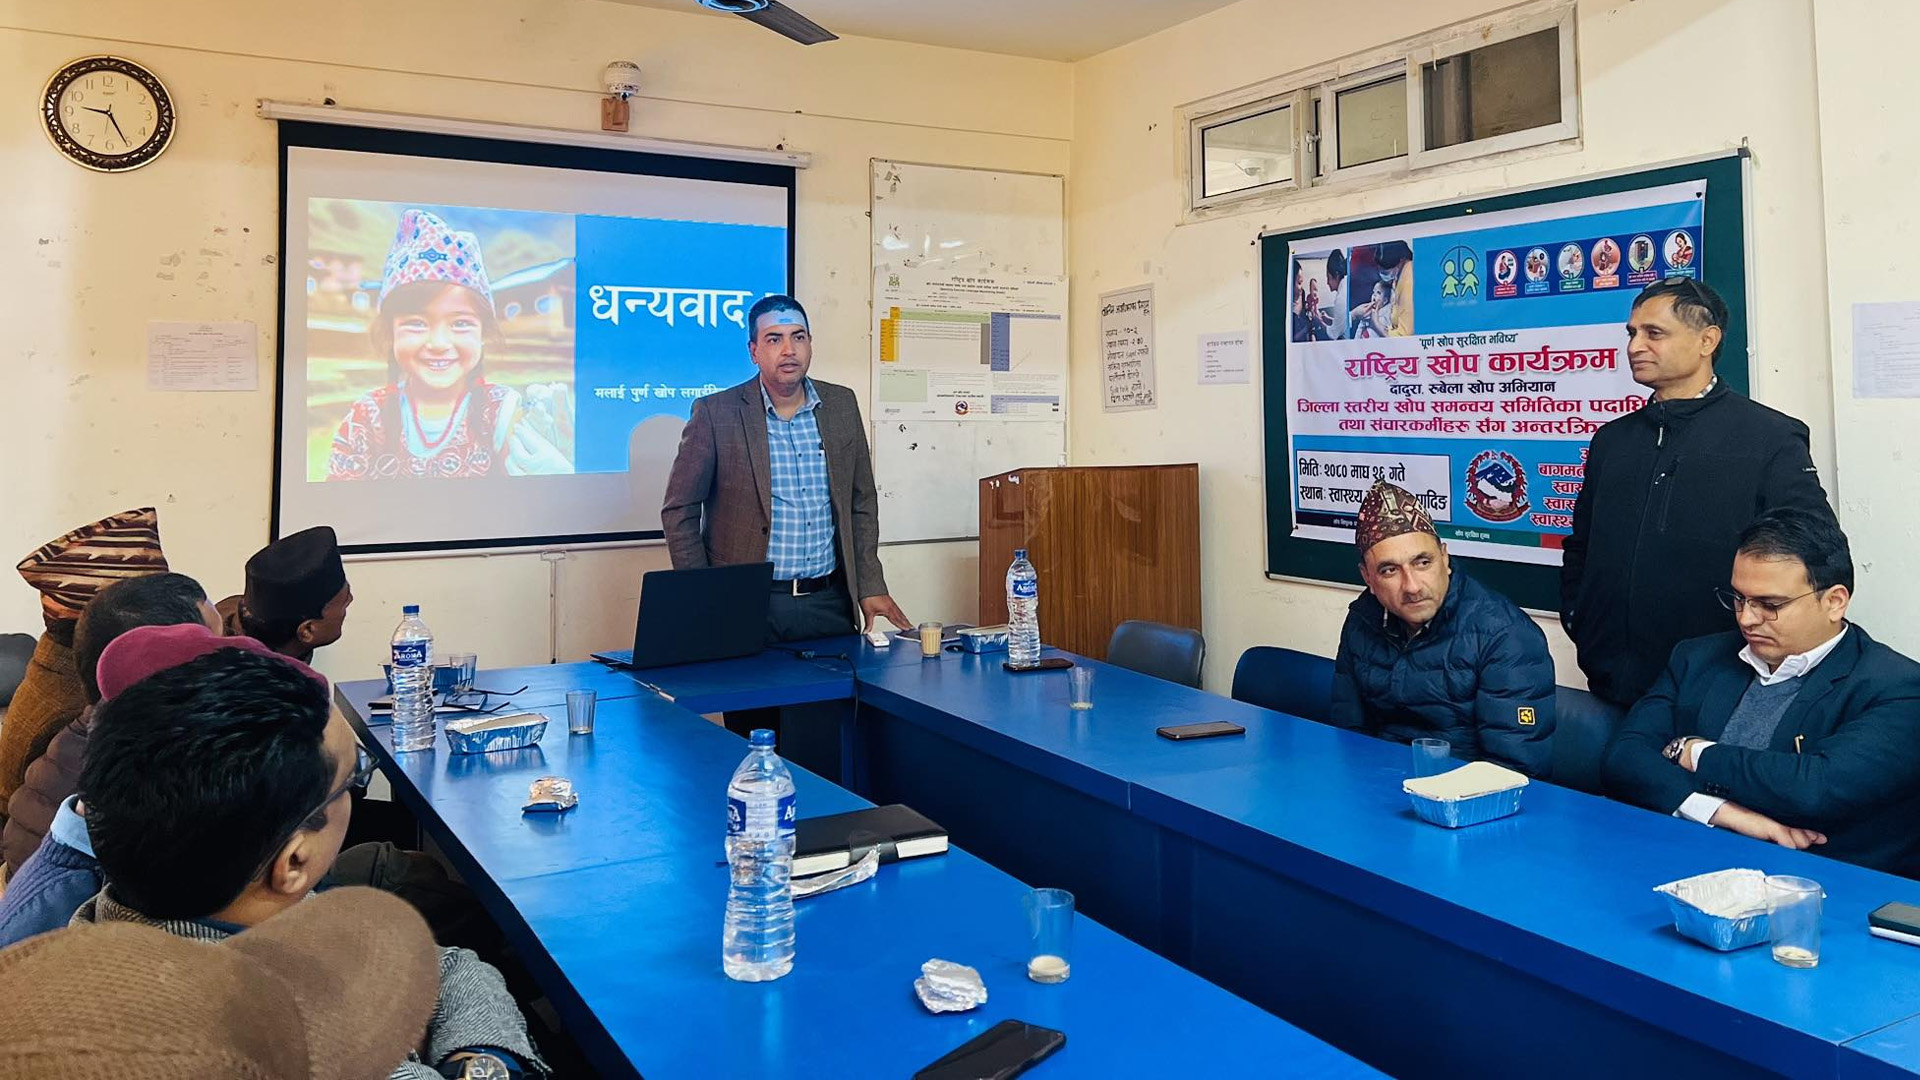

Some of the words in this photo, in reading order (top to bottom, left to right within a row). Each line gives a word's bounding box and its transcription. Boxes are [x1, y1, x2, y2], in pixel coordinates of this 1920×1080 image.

[85, 79, 94, 90] 11
[102, 75, 113, 88] 12
[70, 91, 84, 102] 10
[138, 94, 146, 105] 2
[64, 105, 74, 117] 9
[145, 109, 153, 121] 3
[71, 123, 80, 135] 8
[138, 126, 146, 137] 4
[87, 134, 95, 146] 7
[105, 140, 114, 151] 6
[589, 285, 753, 328] धन्यवाद
[1437, 335, 1454, 347] खोप
[1456, 333, 1487, 348] सुरक्षित
[1344, 352, 1420, 380] राष्ट्रिय
[1426, 349, 1480, 375] खोप
[1488, 345, 1618, 372] कार्यक्रम
[1468, 380, 1494, 394] खोप
[1500, 378, 1556, 393] अभियान
[594, 384, 625, 399] मलाई
[630, 384, 649, 402] पुर्ण
[653, 384, 676, 398] खोप
[1298, 398, 1338, 413] जिल्ला
[1344, 398, 1388, 414] स्तरीय
[1394, 398, 1426, 414] खोप
[1431, 400, 1494, 414] समन्वय
[1500, 396, 1582, 414] समितिका
[1590, 395, 1647, 412] पदाधि
[1339, 419, 1365, 431] तथा
[1476, 416, 1505, 433] सँग
[1512, 417, 1605, 434] अन्तरक्रि
[1324, 464, 1347, 478] २०८०
[1351, 464, 1370, 480] माघ
[1389, 462, 1406, 482] गते
[1328, 488, 1363, 504] स्वास्थ्य
